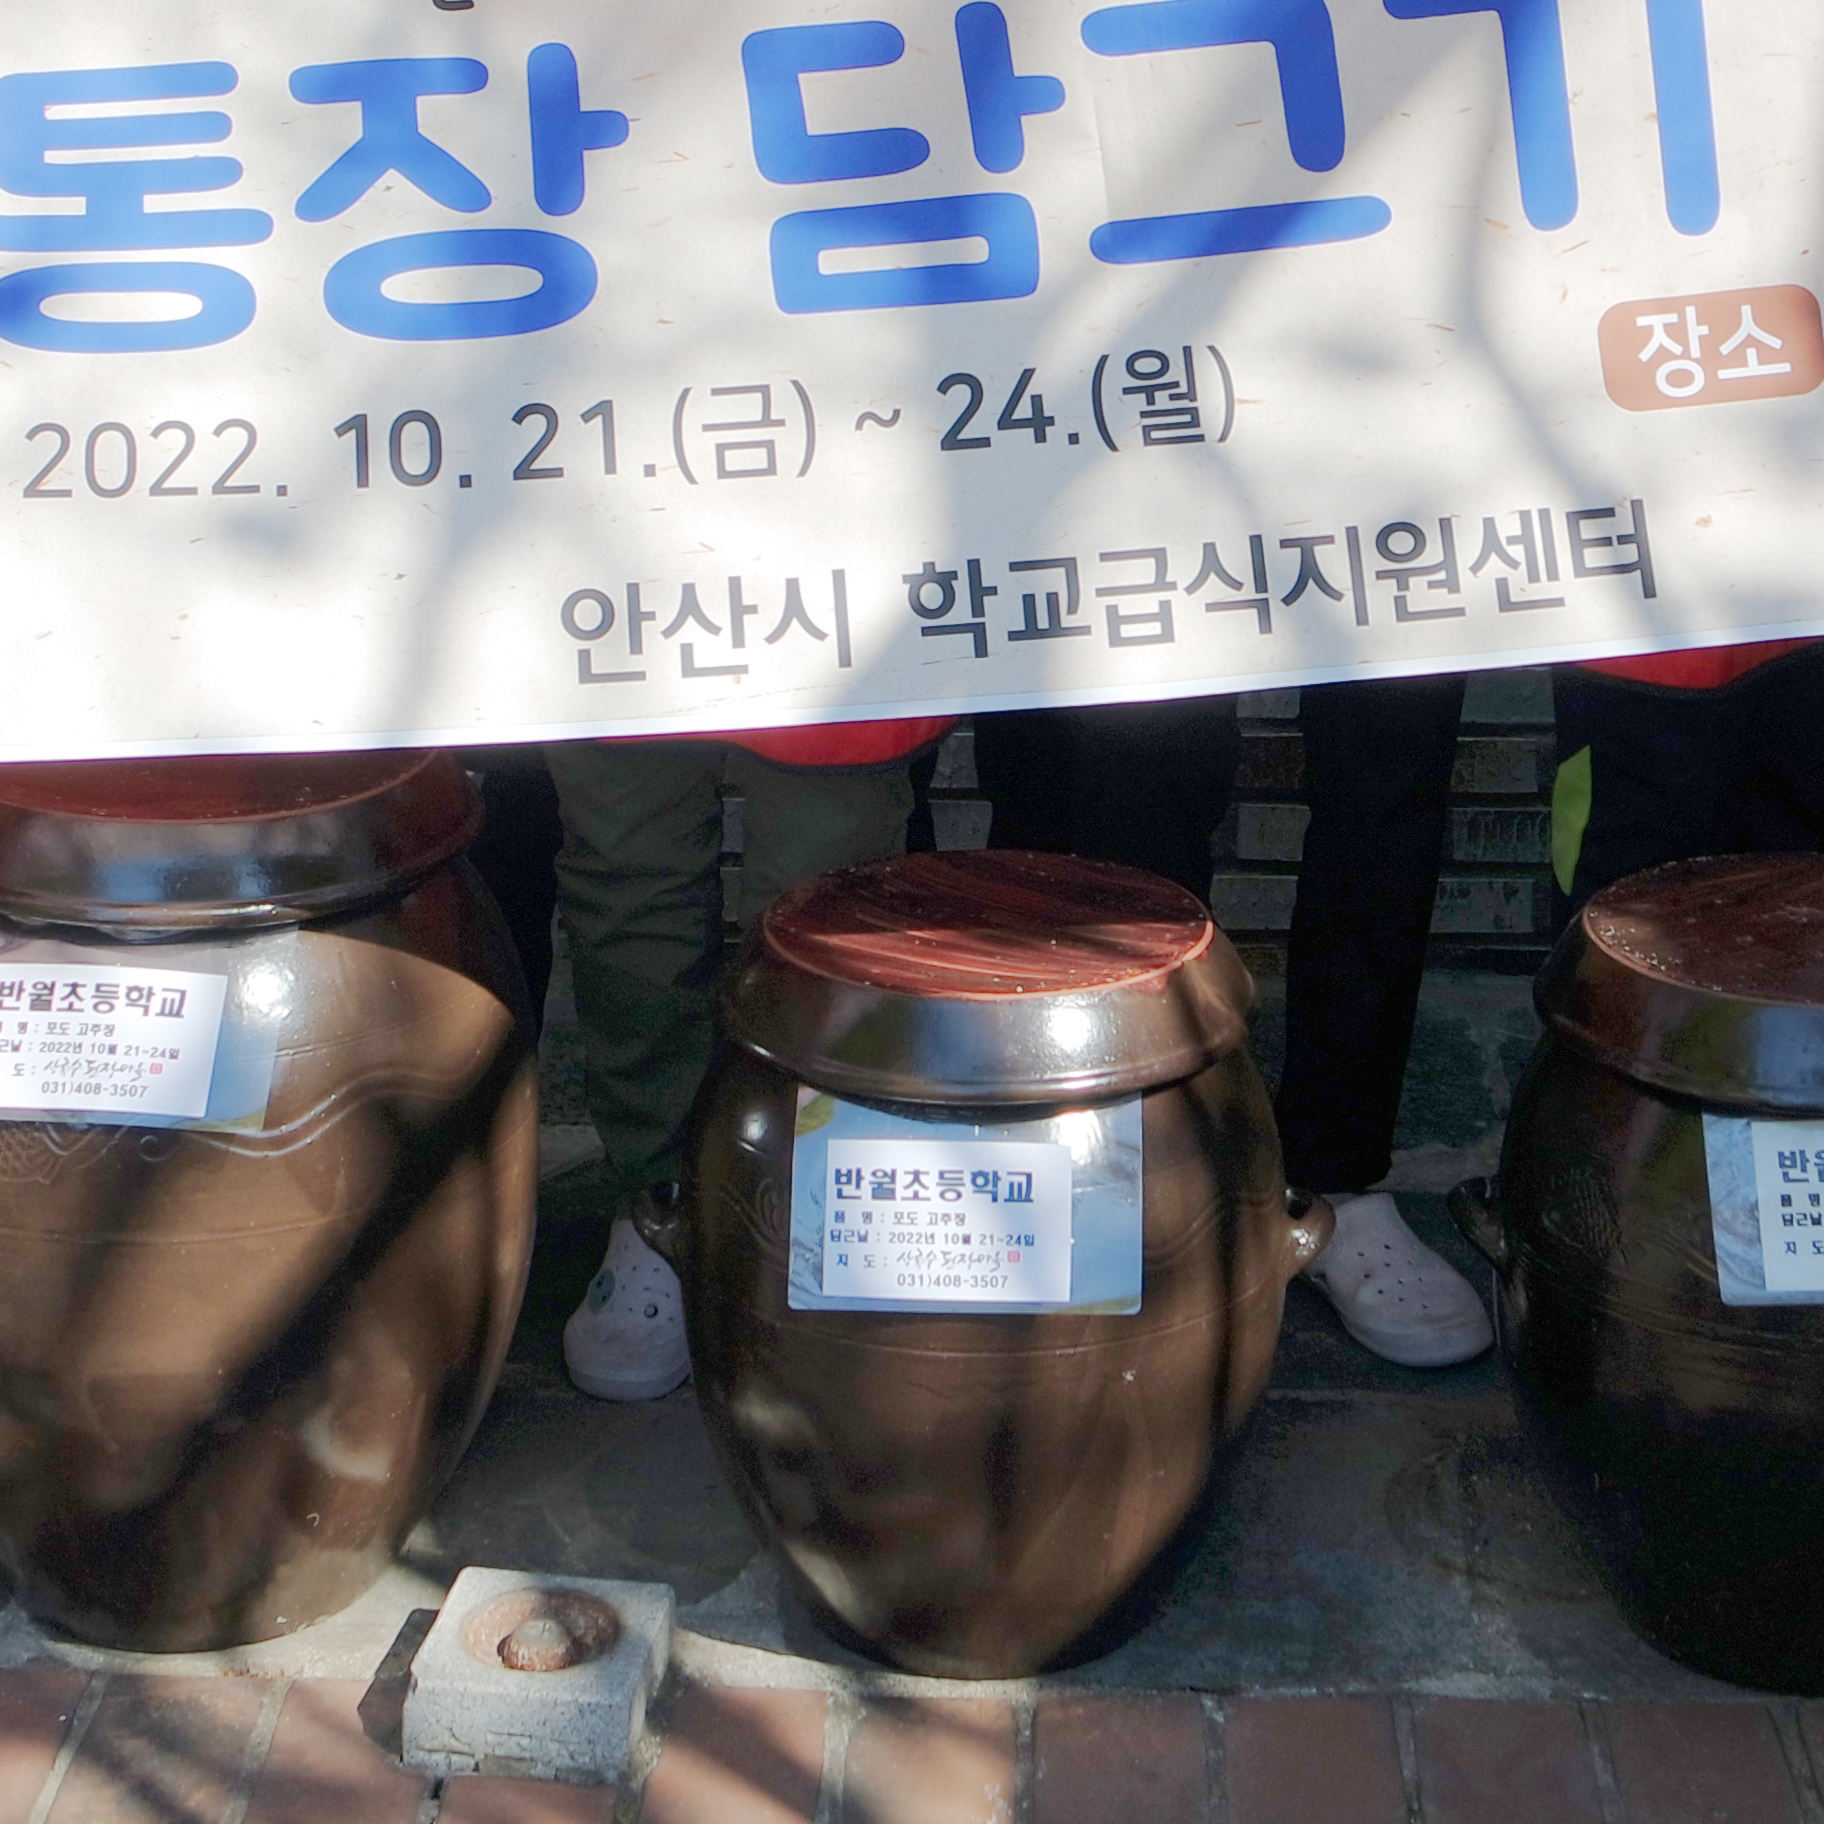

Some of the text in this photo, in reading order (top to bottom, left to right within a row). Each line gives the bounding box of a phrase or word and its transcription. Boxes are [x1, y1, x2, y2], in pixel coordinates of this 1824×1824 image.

[1634, 304, 1792, 398] 장소
[22, 418, 289, 499] 2022.
[333, 409, 474, 489] 10.
[509, 378, 817, 486] 21.(금)
[936, 343, 1236, 452] 24.(월)
[559, 497, 1658, 685] 안산시 학교급식지원센터
[39, 1042, 83, 1054] 2022년
[12, 1063, 25, 1077] 도
[41, 1081, 148, 1098] 031)408-3507
[834, 1167, 1035, 1203] 반월초등학교
[888, 1232, 936, 1245] 2022년
[1784, 1241, 1797, 1255] 지
[836, 1254, 848, 1267] 지
[863, 1254, 876, 1268] 도
[897, 1274, 1009, 1289] 031)408-3507
